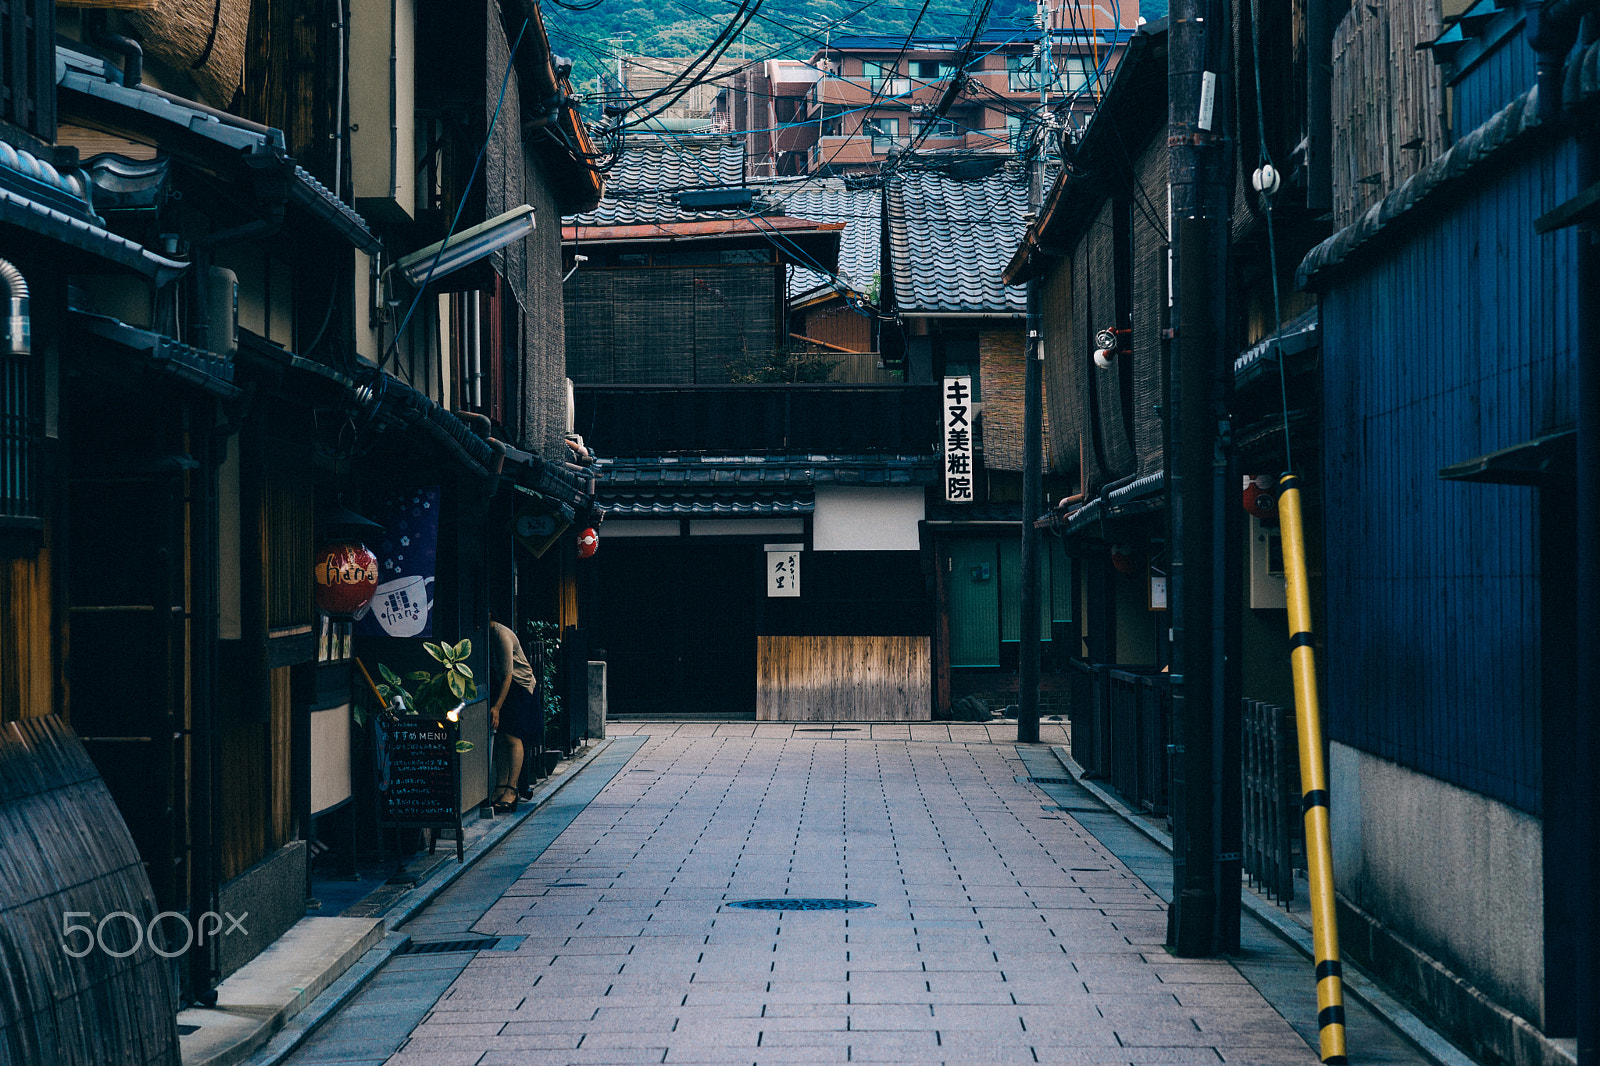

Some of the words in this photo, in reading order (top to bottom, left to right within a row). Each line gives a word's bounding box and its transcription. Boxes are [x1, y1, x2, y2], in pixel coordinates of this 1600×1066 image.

[946, 380, 972, 500] キヌ美粧院
[326, 554, 375, 586] hana
[774, 561, 787, 589] 久里
[386, 606, 420, 626] hana
[381, 731, 417, 742] おすすめ
[419, 731, 448, 741] MENU
